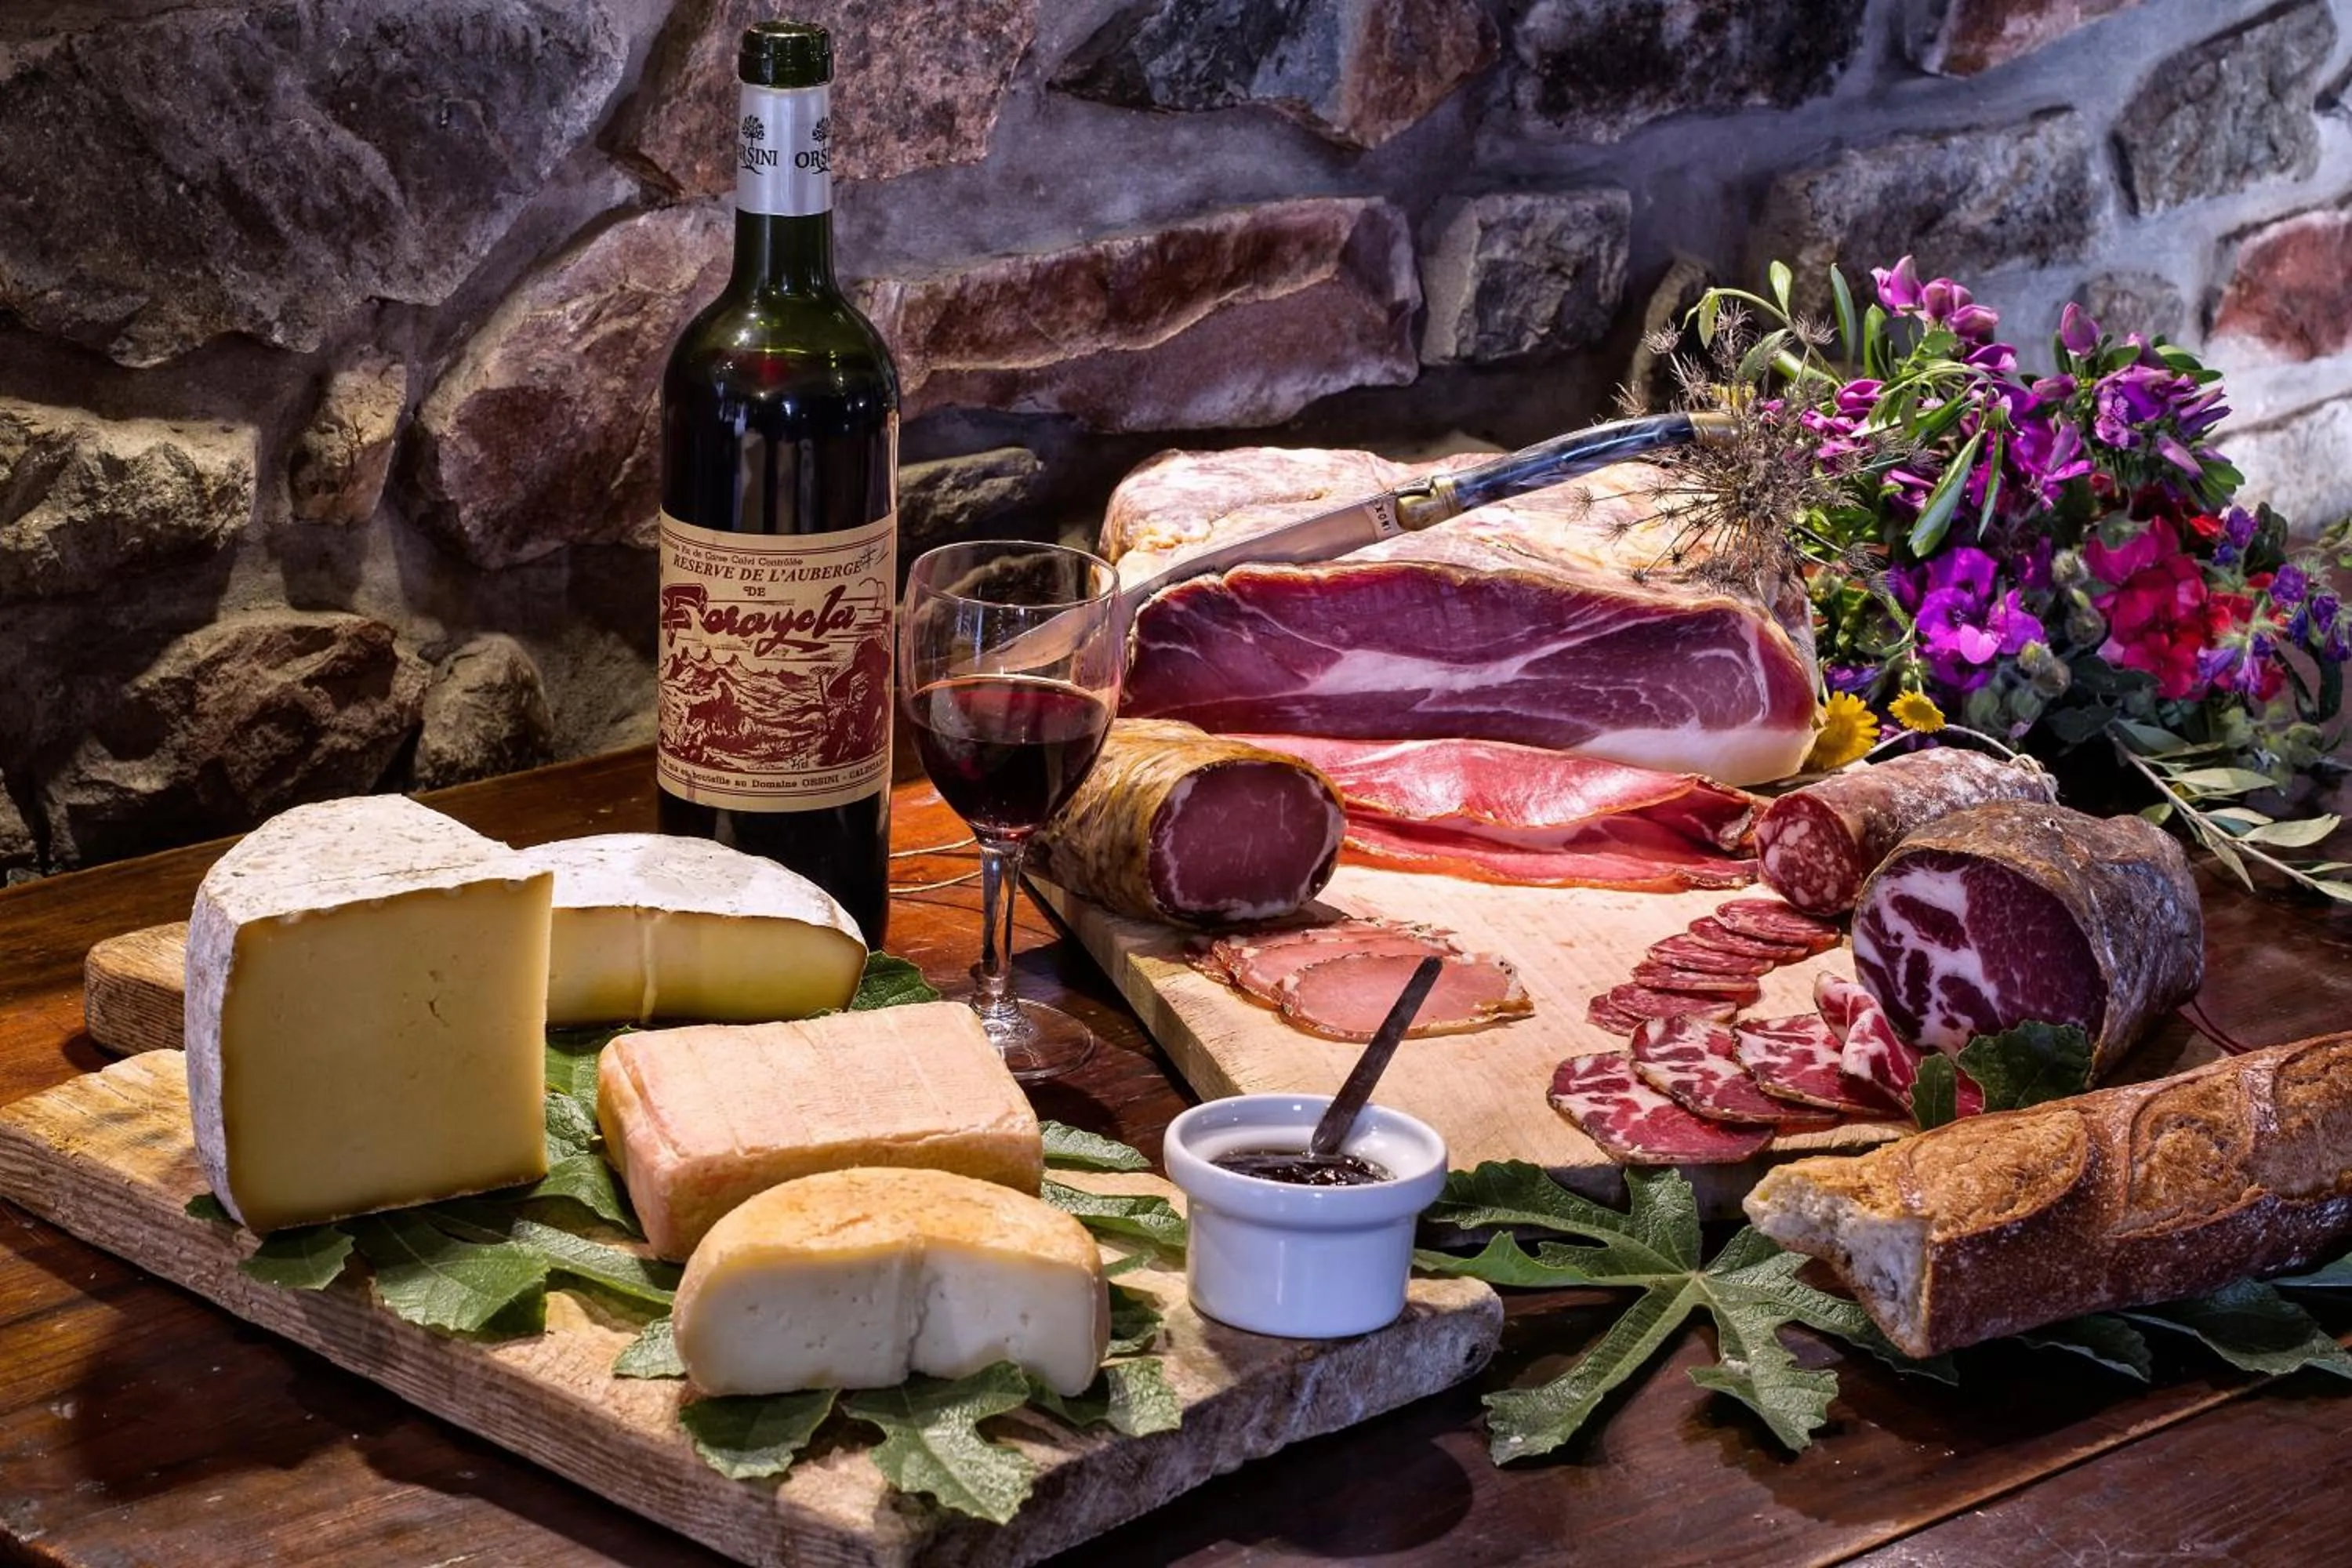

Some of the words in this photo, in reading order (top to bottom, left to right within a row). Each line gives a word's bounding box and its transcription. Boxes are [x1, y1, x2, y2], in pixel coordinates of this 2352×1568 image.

[673, 554, 735, 579] RESERVE
[739, 568, 764, 582] DE
[768, 561, 863, 583] L'AUBERGE
[742, 586, 766, 597] DE
[752, 778, 797, 789] Domaine
